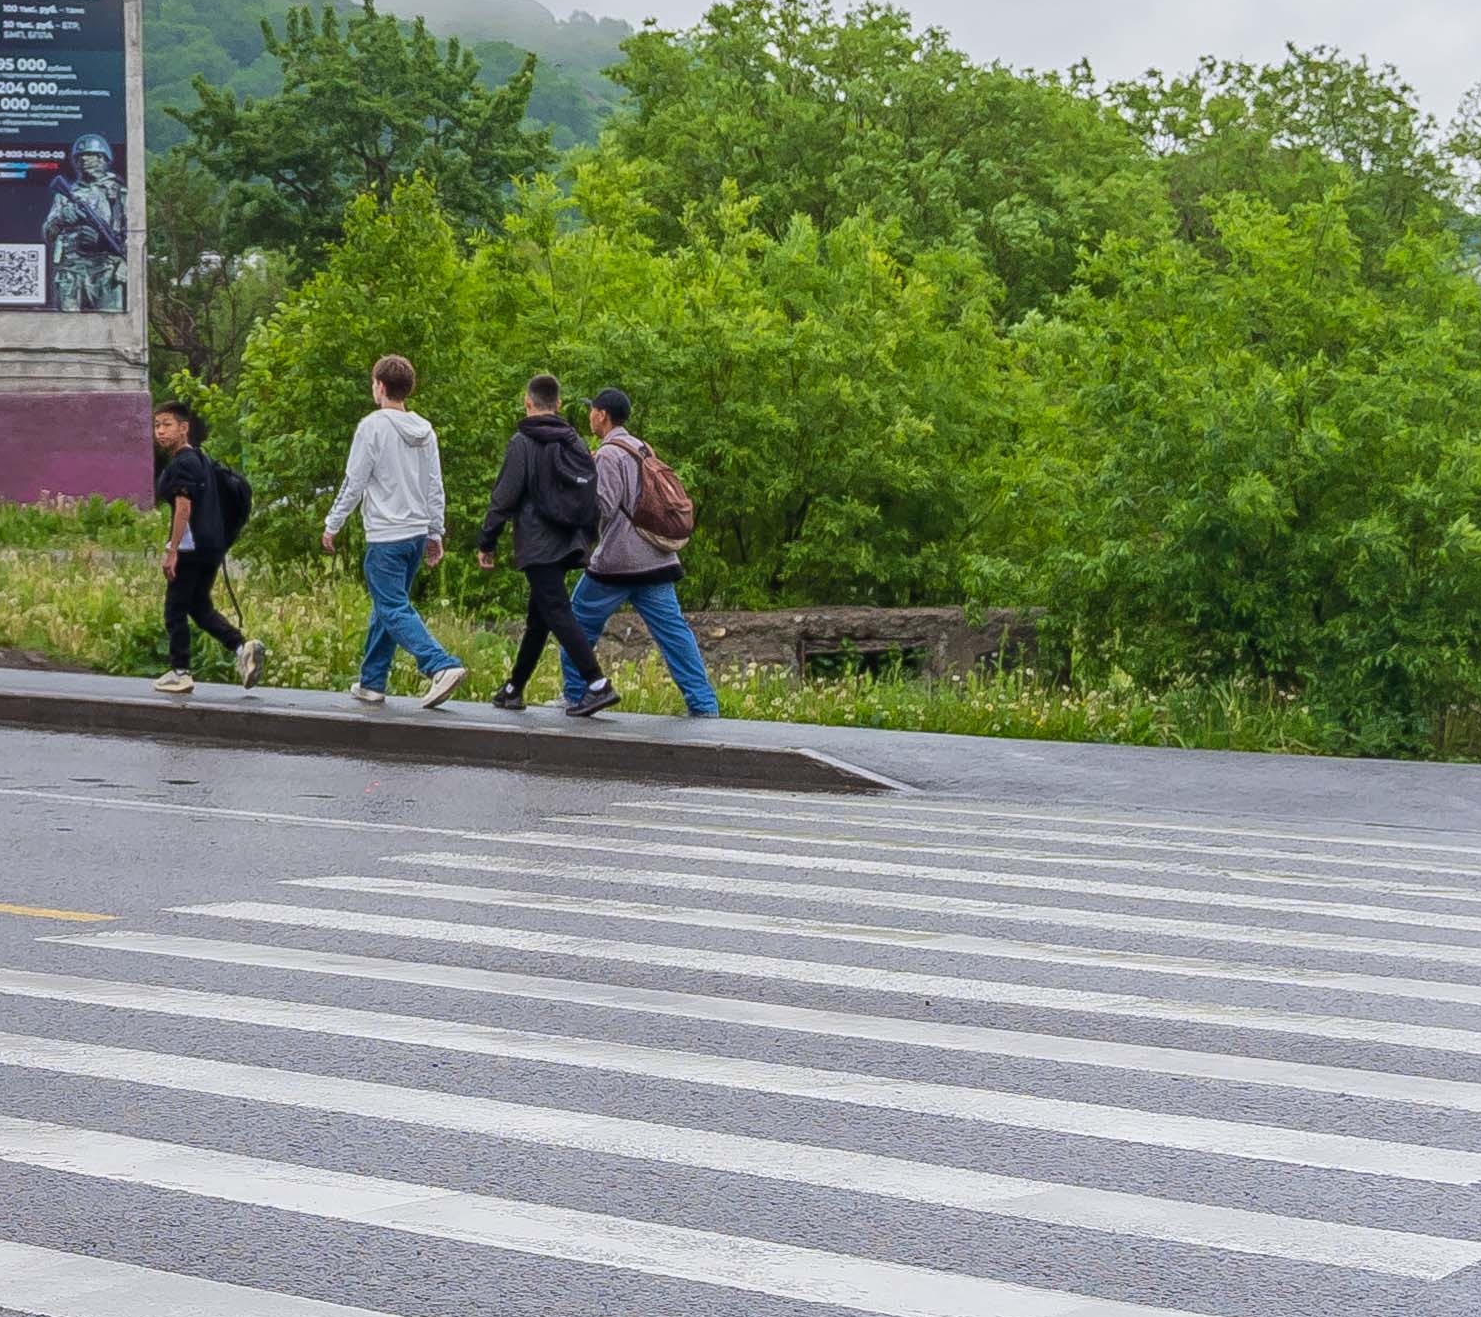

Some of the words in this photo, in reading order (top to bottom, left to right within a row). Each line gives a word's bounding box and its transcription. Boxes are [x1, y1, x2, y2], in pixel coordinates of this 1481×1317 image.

[17, 58, 47, 71] 000
[28, 82, 57, 94] 000
[1, 98, 29, 110] 000
